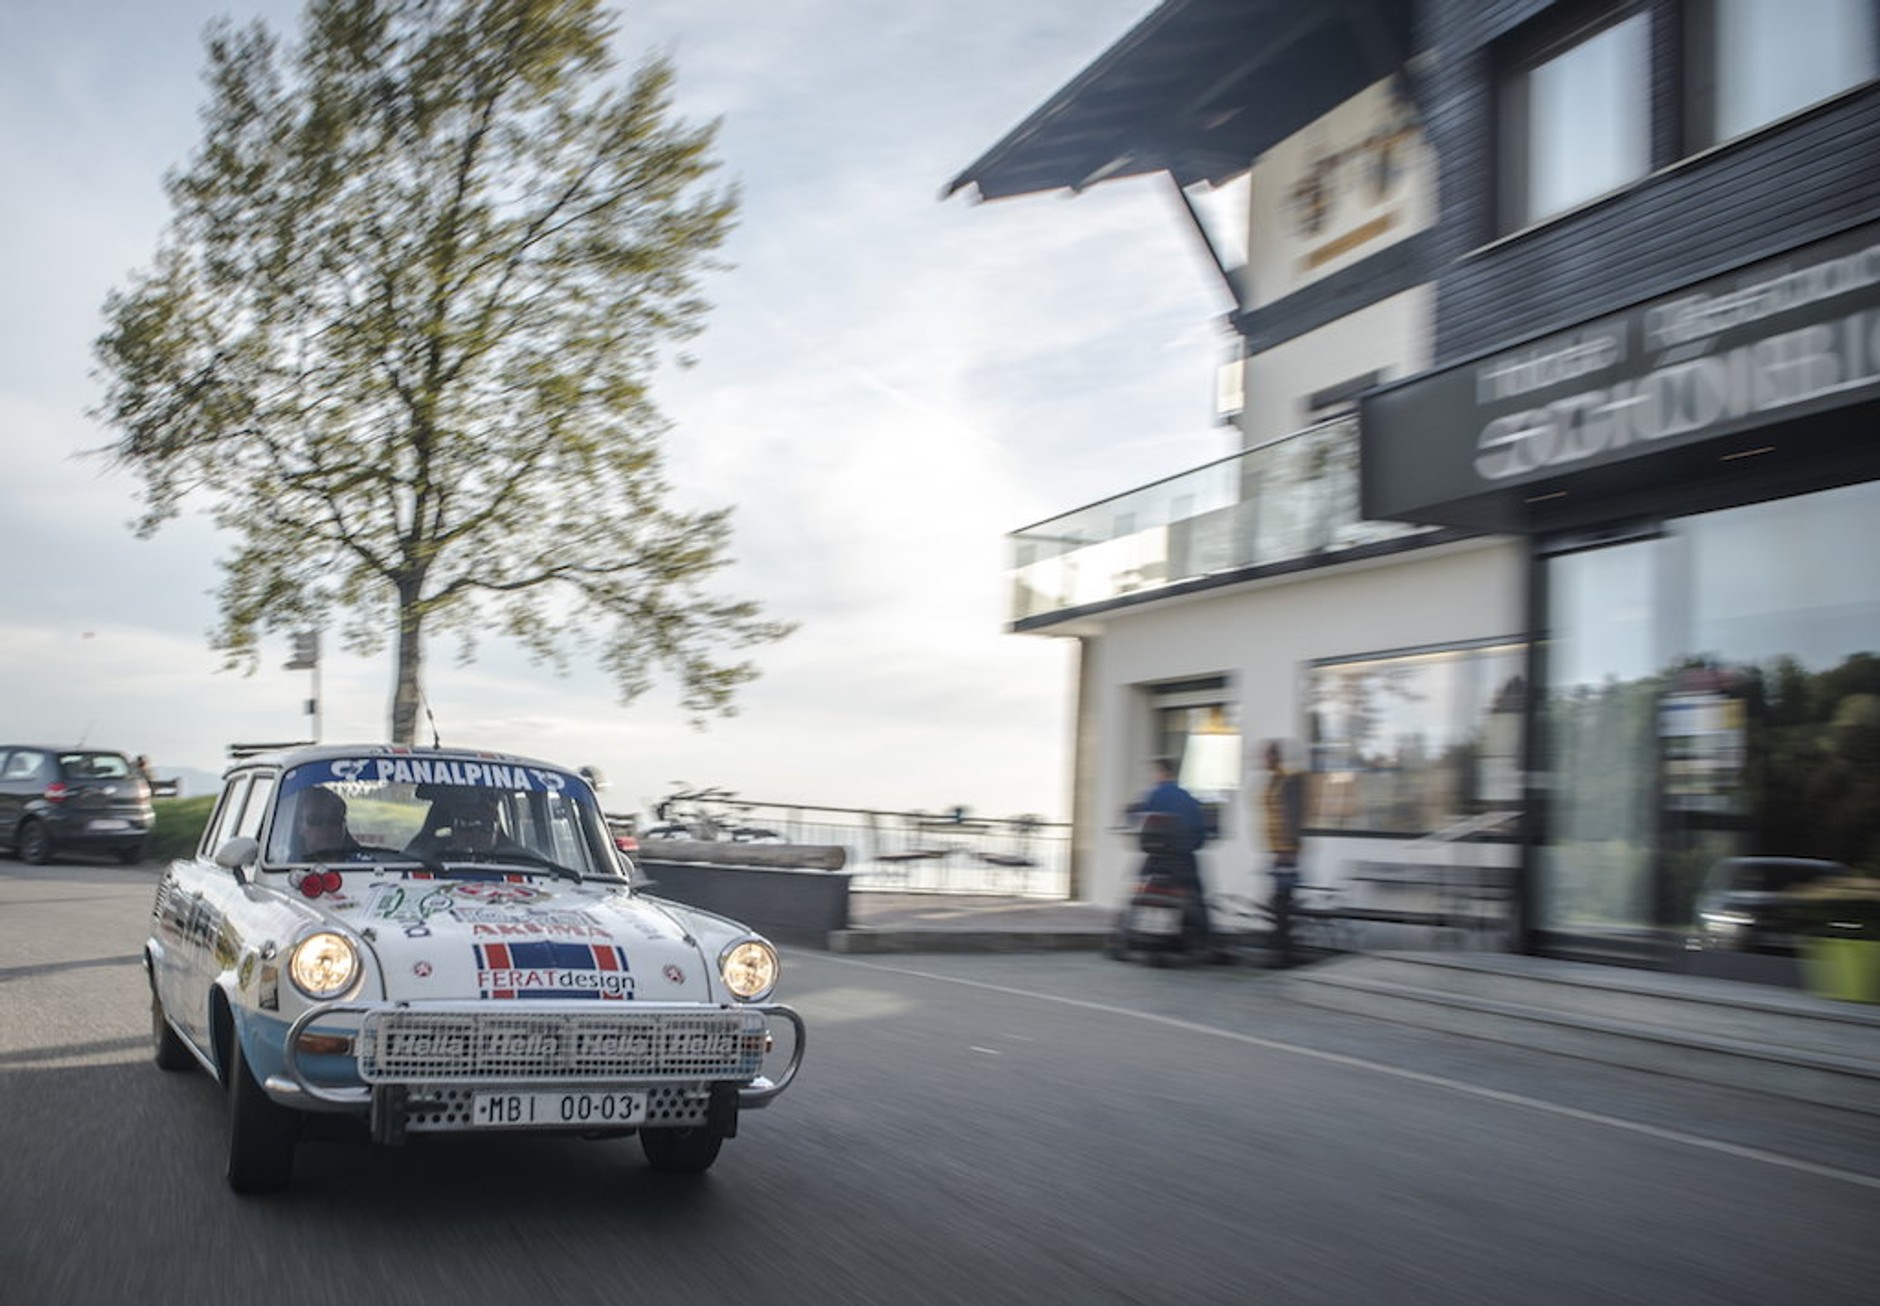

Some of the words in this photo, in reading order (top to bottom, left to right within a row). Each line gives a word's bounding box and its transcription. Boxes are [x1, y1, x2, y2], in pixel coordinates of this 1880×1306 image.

[376, 759, 532, 791] PANALPINA
[477, 970, 635, 994] FERATdesign
[488, 1096, 535, 1122] MBI
